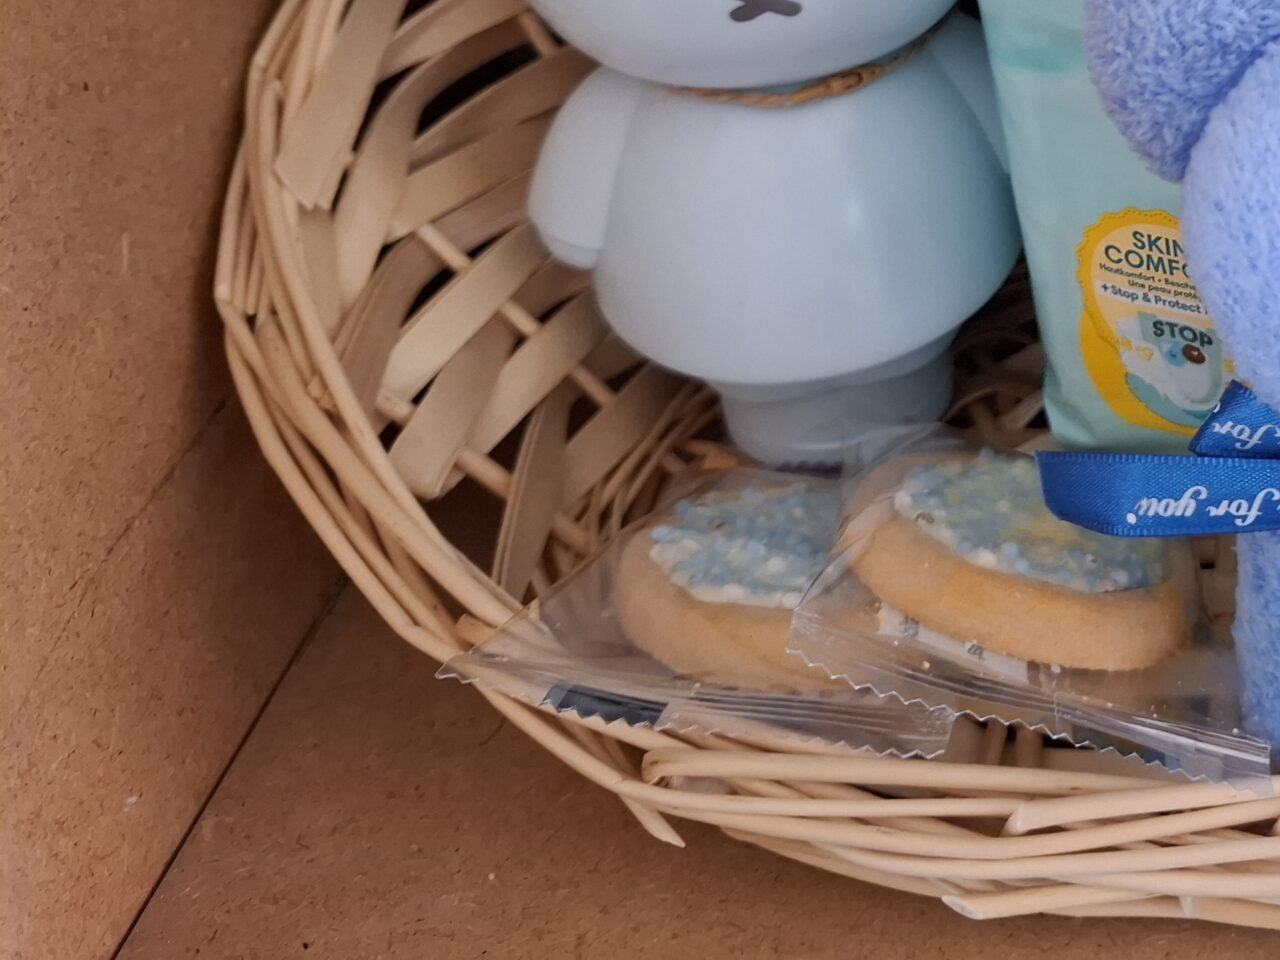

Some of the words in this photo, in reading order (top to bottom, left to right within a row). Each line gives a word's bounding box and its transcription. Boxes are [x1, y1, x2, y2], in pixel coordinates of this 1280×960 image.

[1104, 243, 1191, 279] COMF
[1128, 279, 1146, 290] Une
[1148, 283, 1172, 296] peau
[1174, 289, 1202, 302] proté
[1141, 292, 1153, 304] &
[1154, 295, 1202, 315] Protect
[1152, 319, 1213, 348] STOP
[1134, 485, 1208, 520] you
[1205, 487, 1280, 527] for
